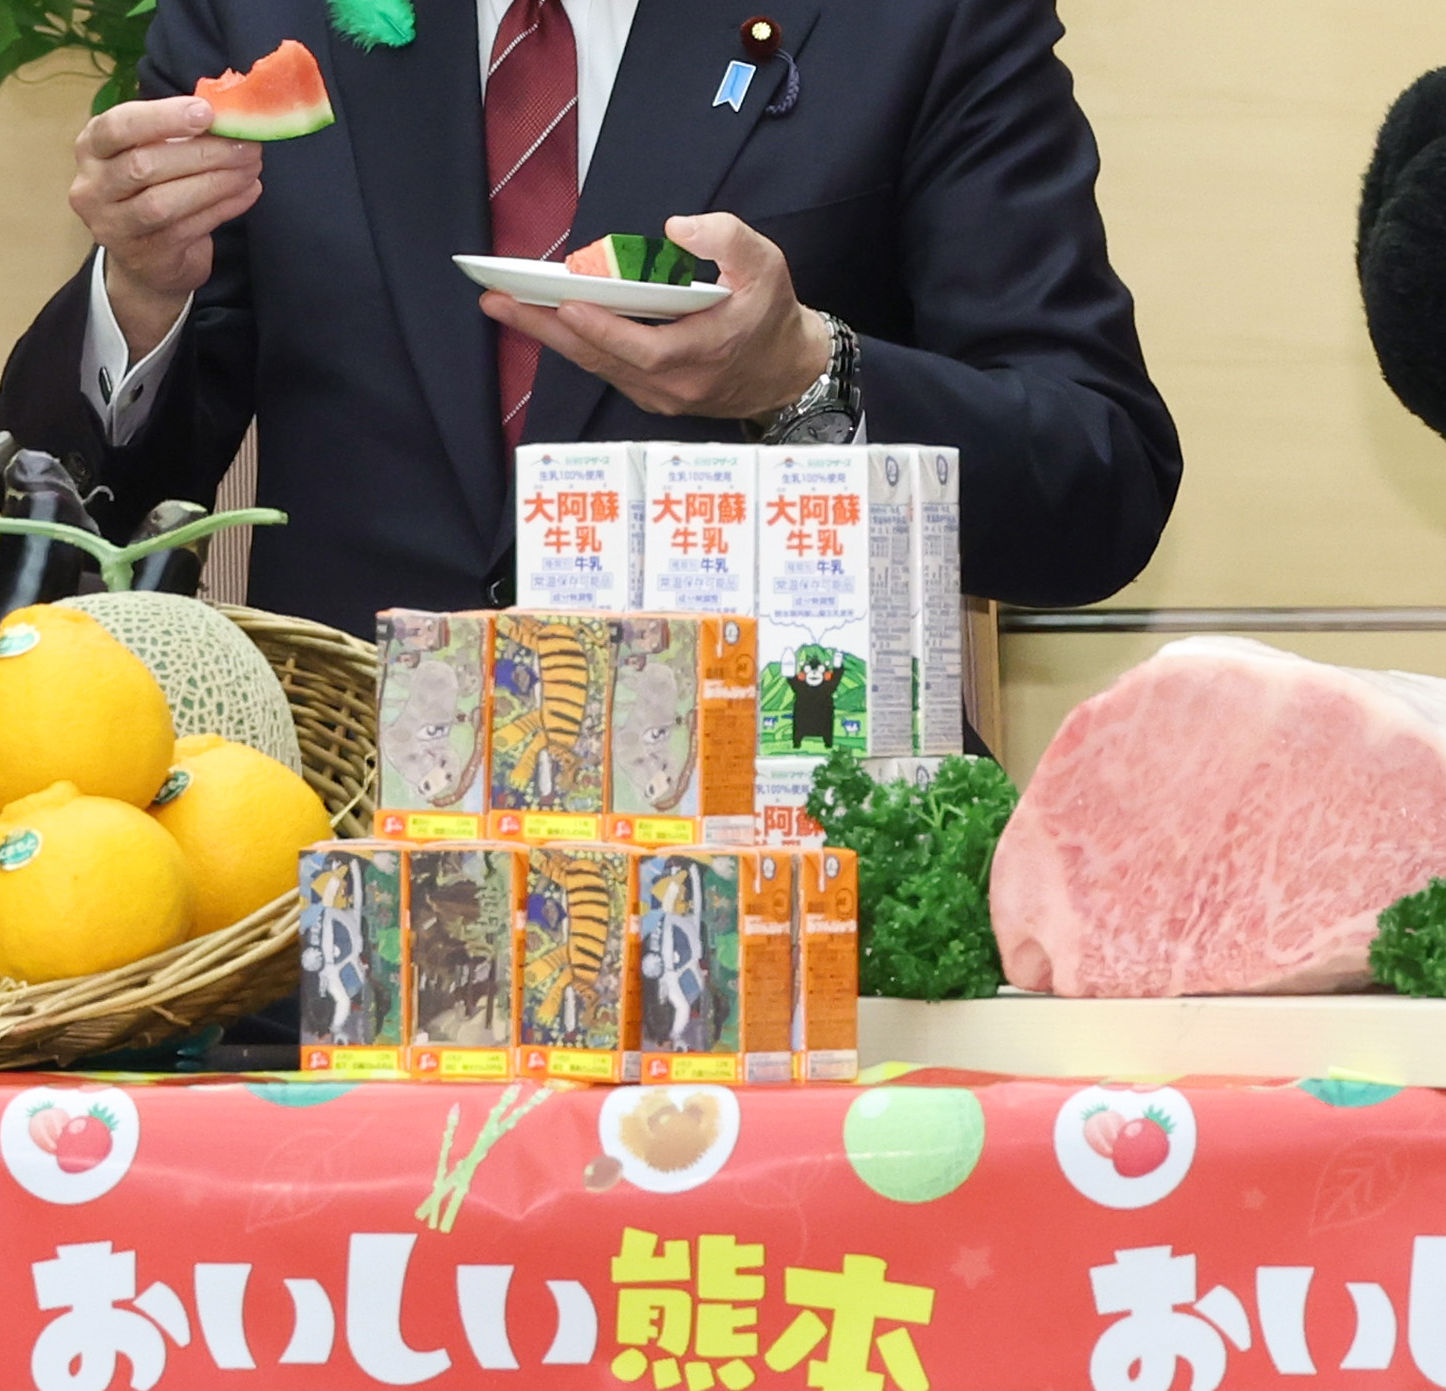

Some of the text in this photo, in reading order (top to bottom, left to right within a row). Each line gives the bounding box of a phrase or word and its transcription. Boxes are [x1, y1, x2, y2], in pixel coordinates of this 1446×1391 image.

[523, 490, 620, 523] 大阿蘇
[651, 492, 747, 524] 大阿蘇
[766, 493, 861, 526] 大阿蘇
[543, 525, 602, 553] 牛乳
[670, 526, 729, 554] 牛乳
[786, 528, 844, 556] 牛乳
